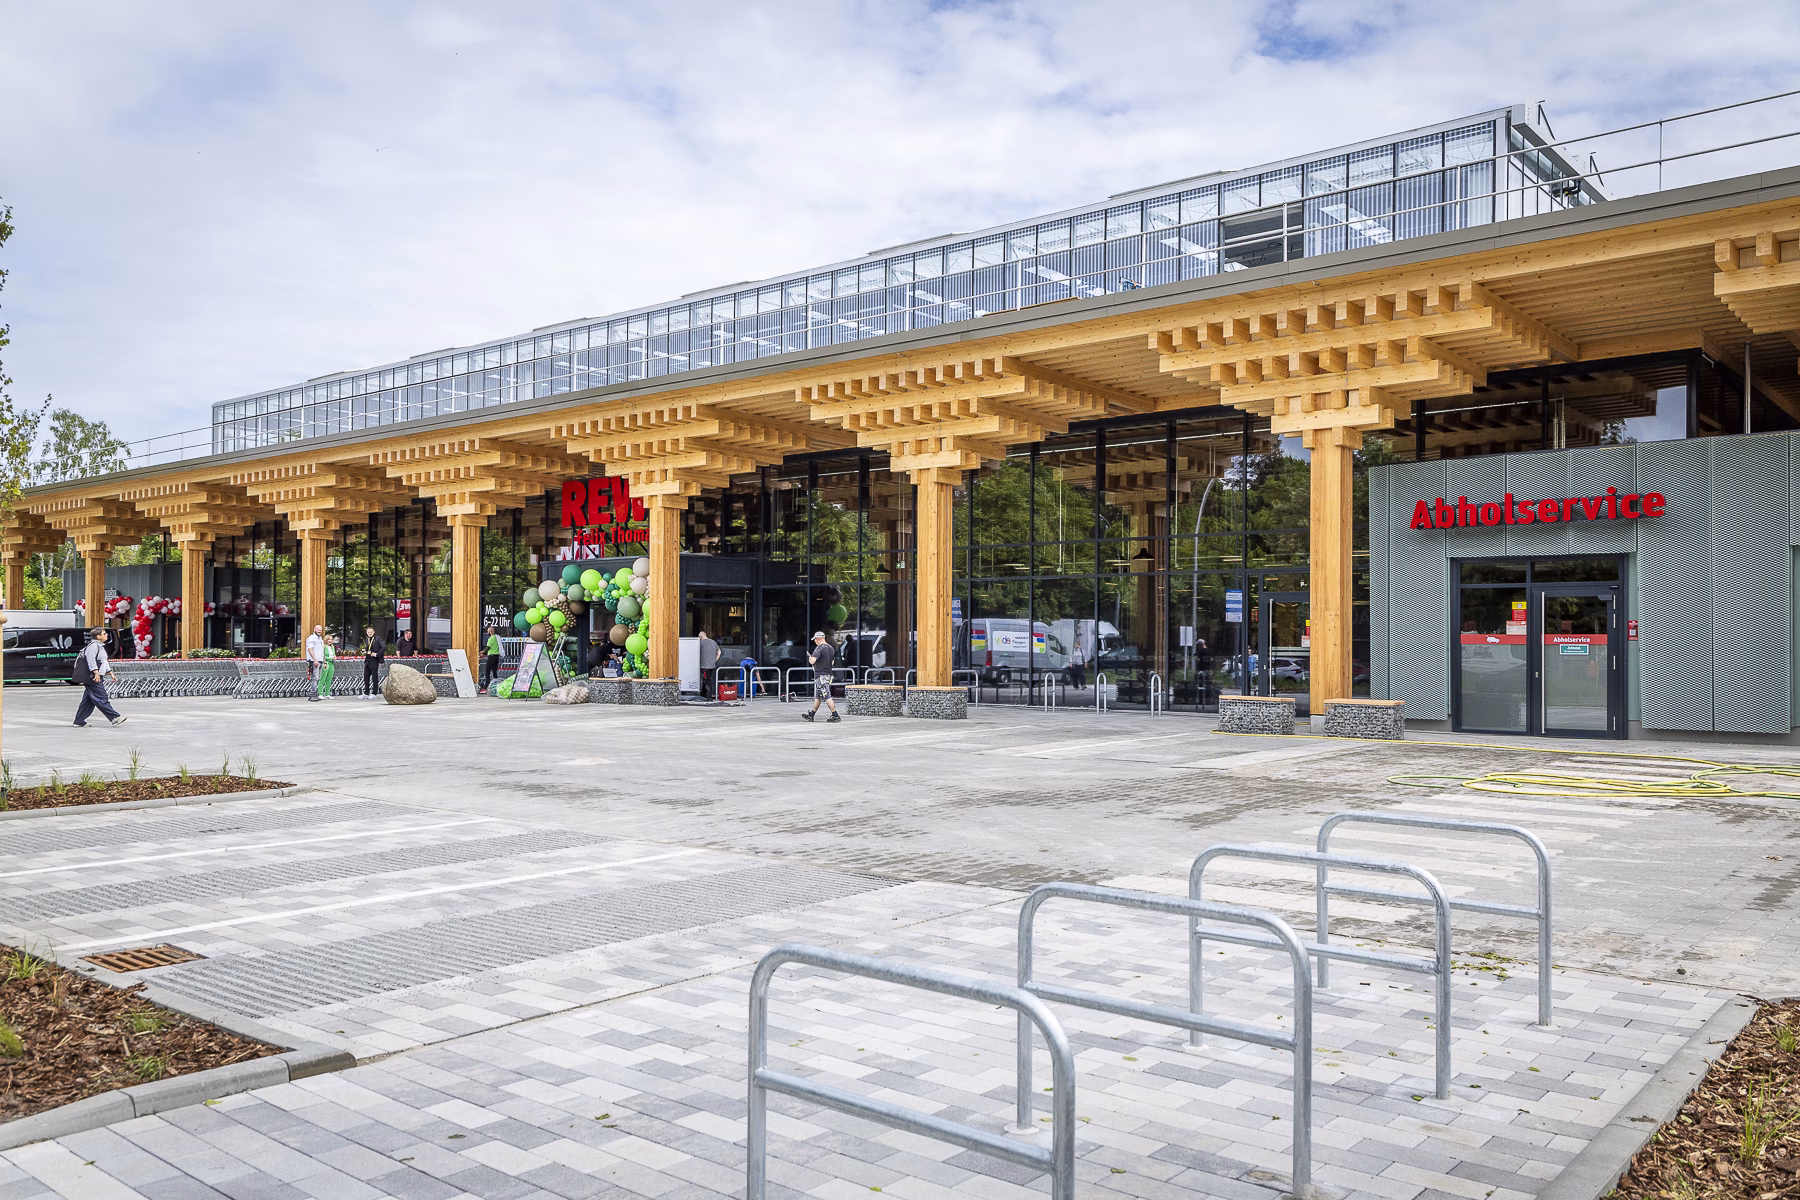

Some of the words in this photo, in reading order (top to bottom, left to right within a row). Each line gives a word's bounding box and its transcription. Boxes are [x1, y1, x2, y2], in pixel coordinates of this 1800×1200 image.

[1409, 486, 1667, 530] Abholservice
[577, 528, 607, 546] Felix
[484, 616, 498, 626] 6–22
[500, 617, 510, 627] Uhr
